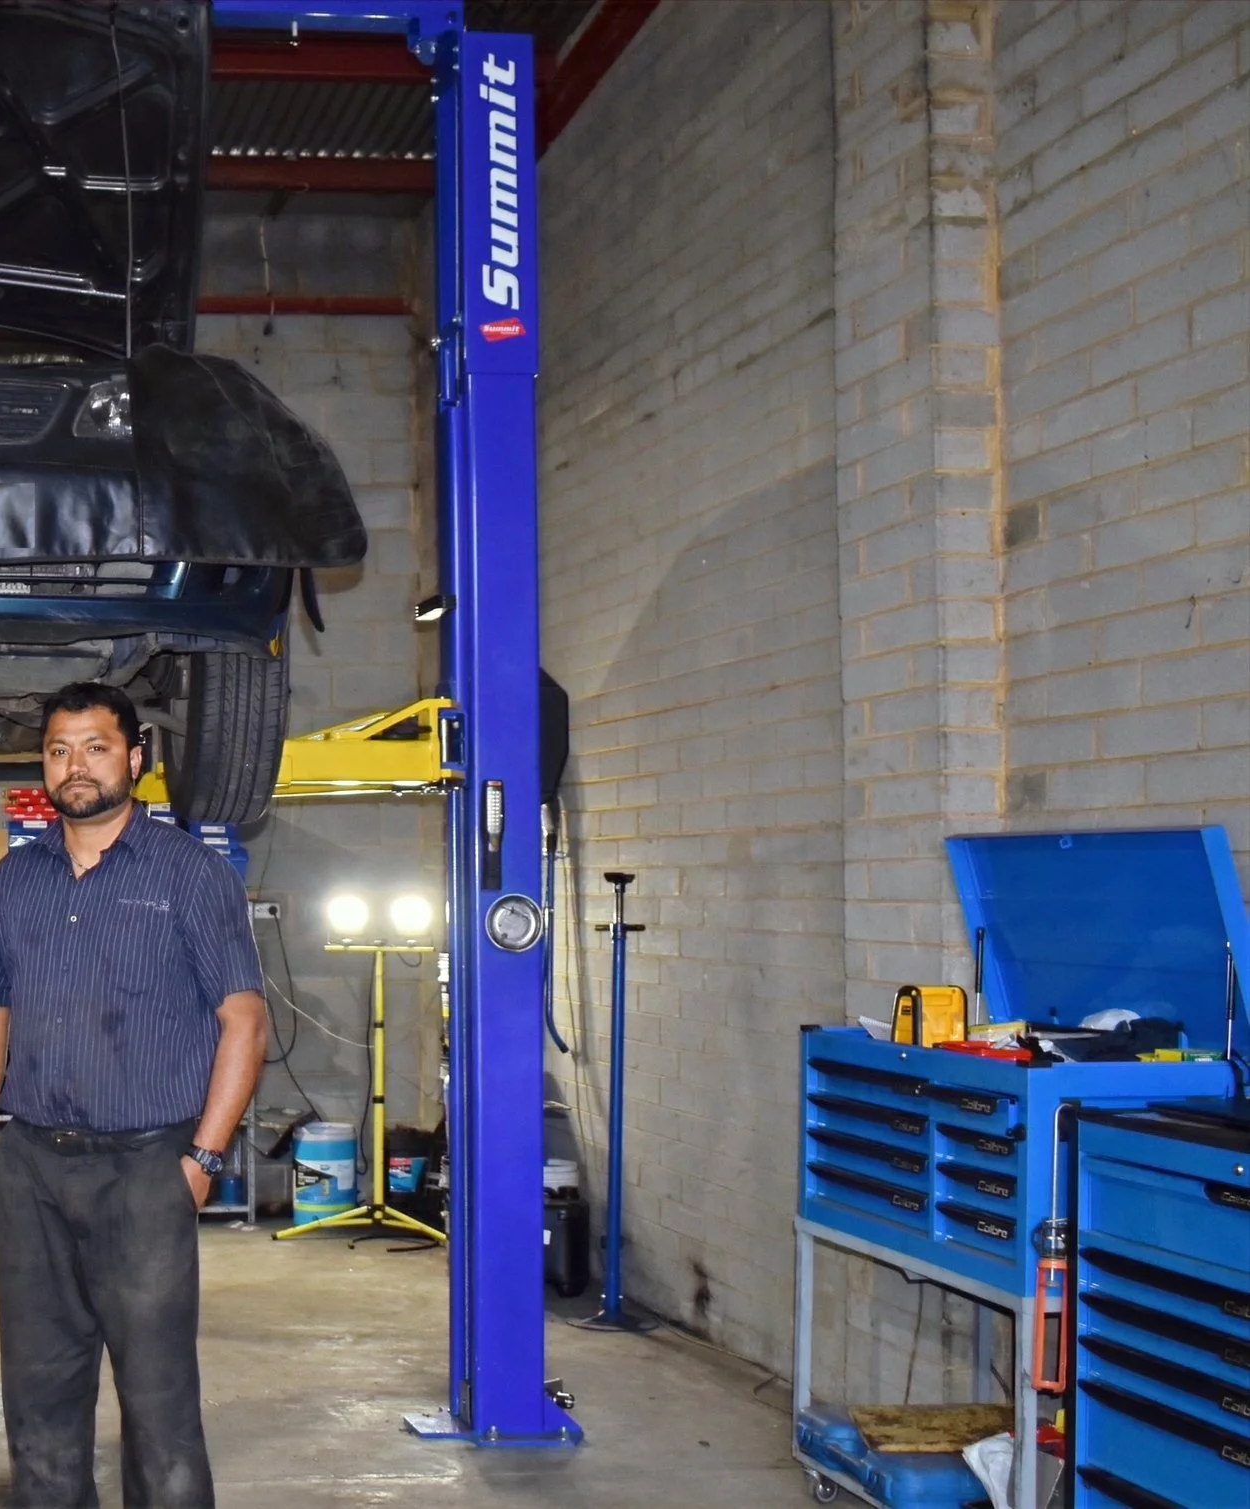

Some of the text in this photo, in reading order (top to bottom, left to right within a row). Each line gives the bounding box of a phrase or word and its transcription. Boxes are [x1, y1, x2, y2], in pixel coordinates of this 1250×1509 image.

[480, 53, 520, 310] Summit
[961, 1098, 991, 1113] Calibre
[978, 1139, 1009, 1155] Calibre
[977, 1180, 1009, 1197] Calibre
[977, 1220, 1008, 1239] Calibre
